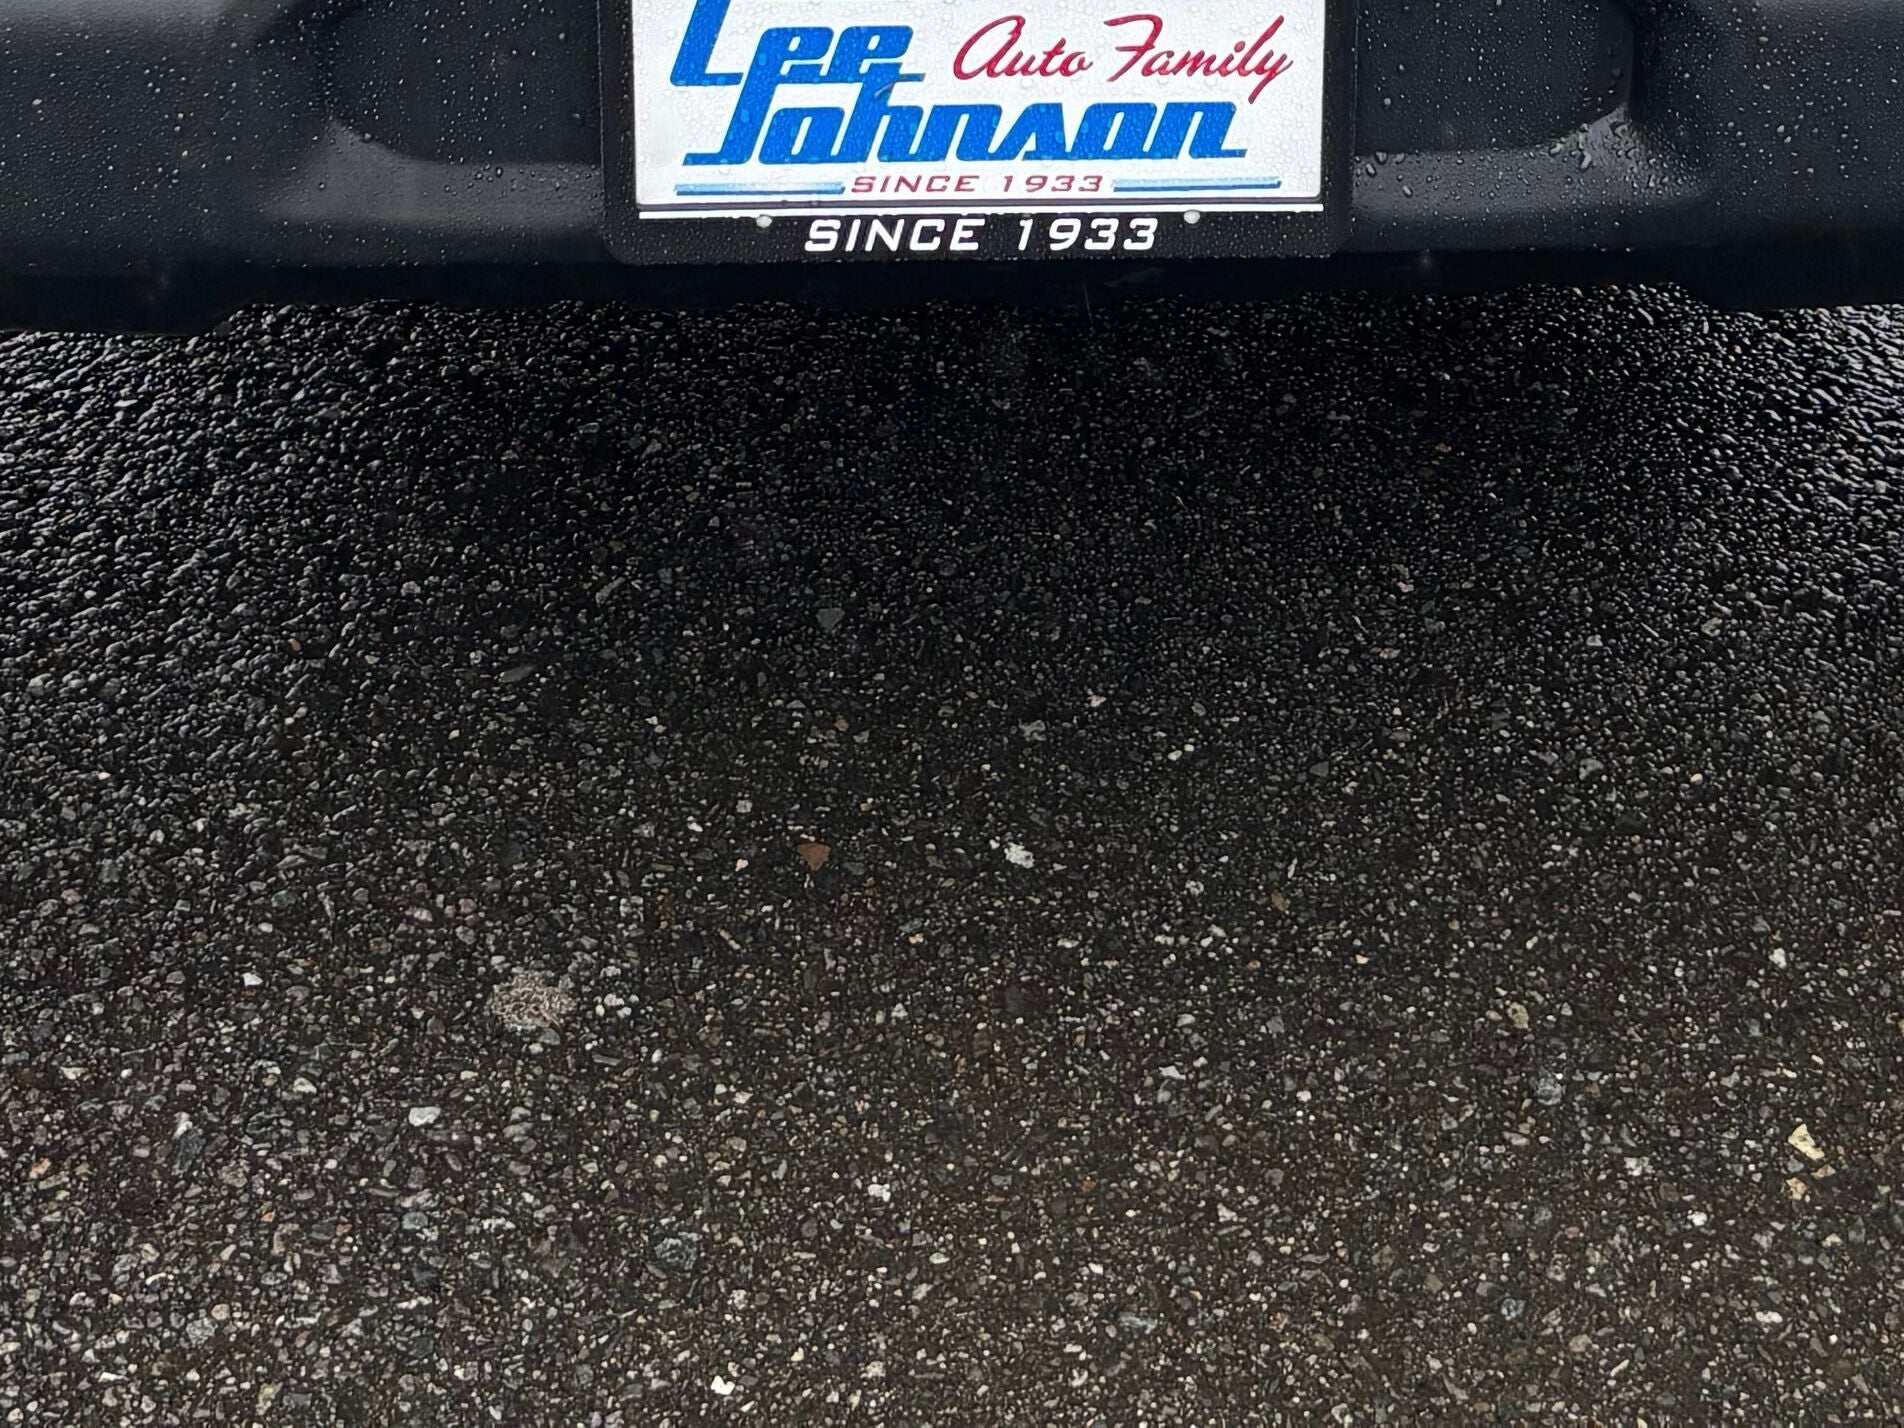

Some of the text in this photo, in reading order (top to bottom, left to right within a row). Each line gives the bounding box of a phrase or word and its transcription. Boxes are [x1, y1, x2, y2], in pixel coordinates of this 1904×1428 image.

[952, 13, 1294, 105] Auto Family
[682, 74, 1248, 167] Johnson
[851, 174, 1104, 193] SINCE 1933
[803, 216, 1159, 253] SINCE 1933
